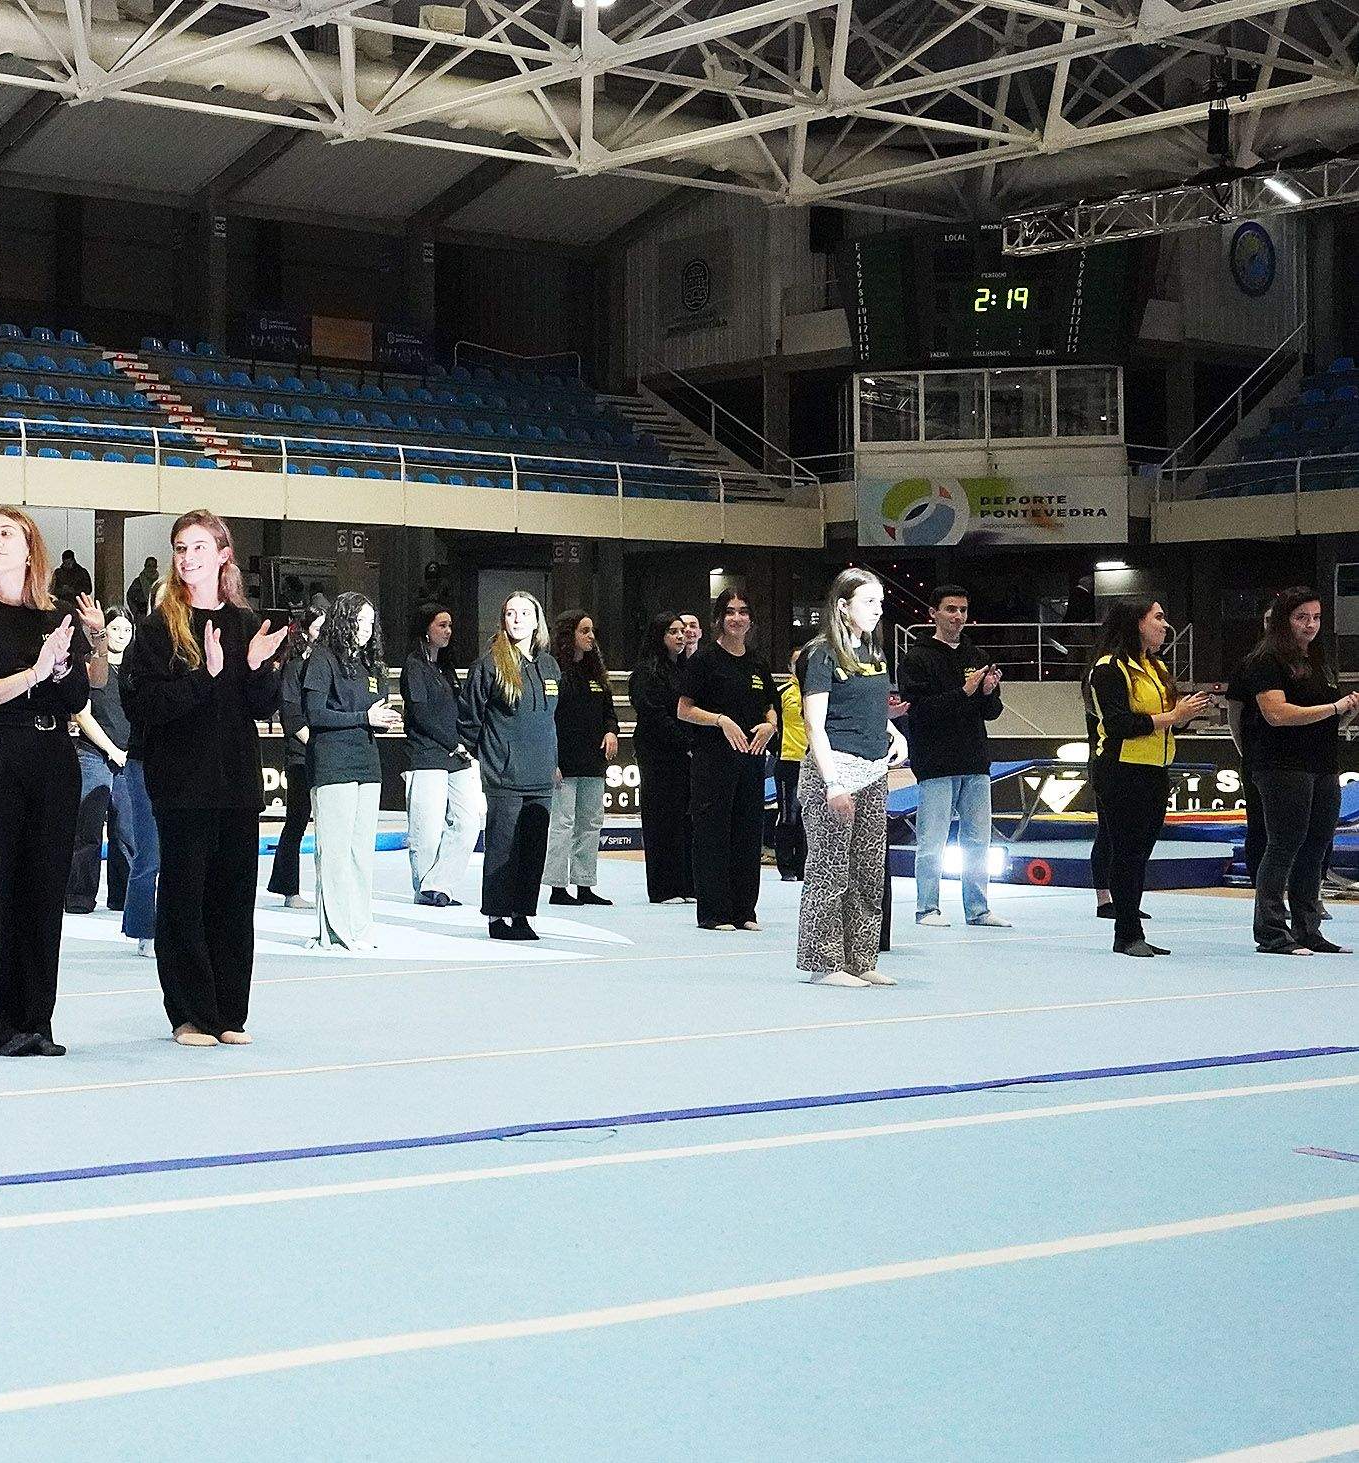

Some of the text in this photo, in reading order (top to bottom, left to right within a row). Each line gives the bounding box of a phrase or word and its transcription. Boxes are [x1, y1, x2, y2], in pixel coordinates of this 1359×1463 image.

[944, 234, 966, 242] LOCAL
[974, 287, 1029, 312] 2:19
[980, 495, 1067, 505] DEPORTE
[980, 508, 1108, 519] PONTEVEDRA
[353, 535, 363, 547] C
[607, 836, 631, 845] SPIETH
